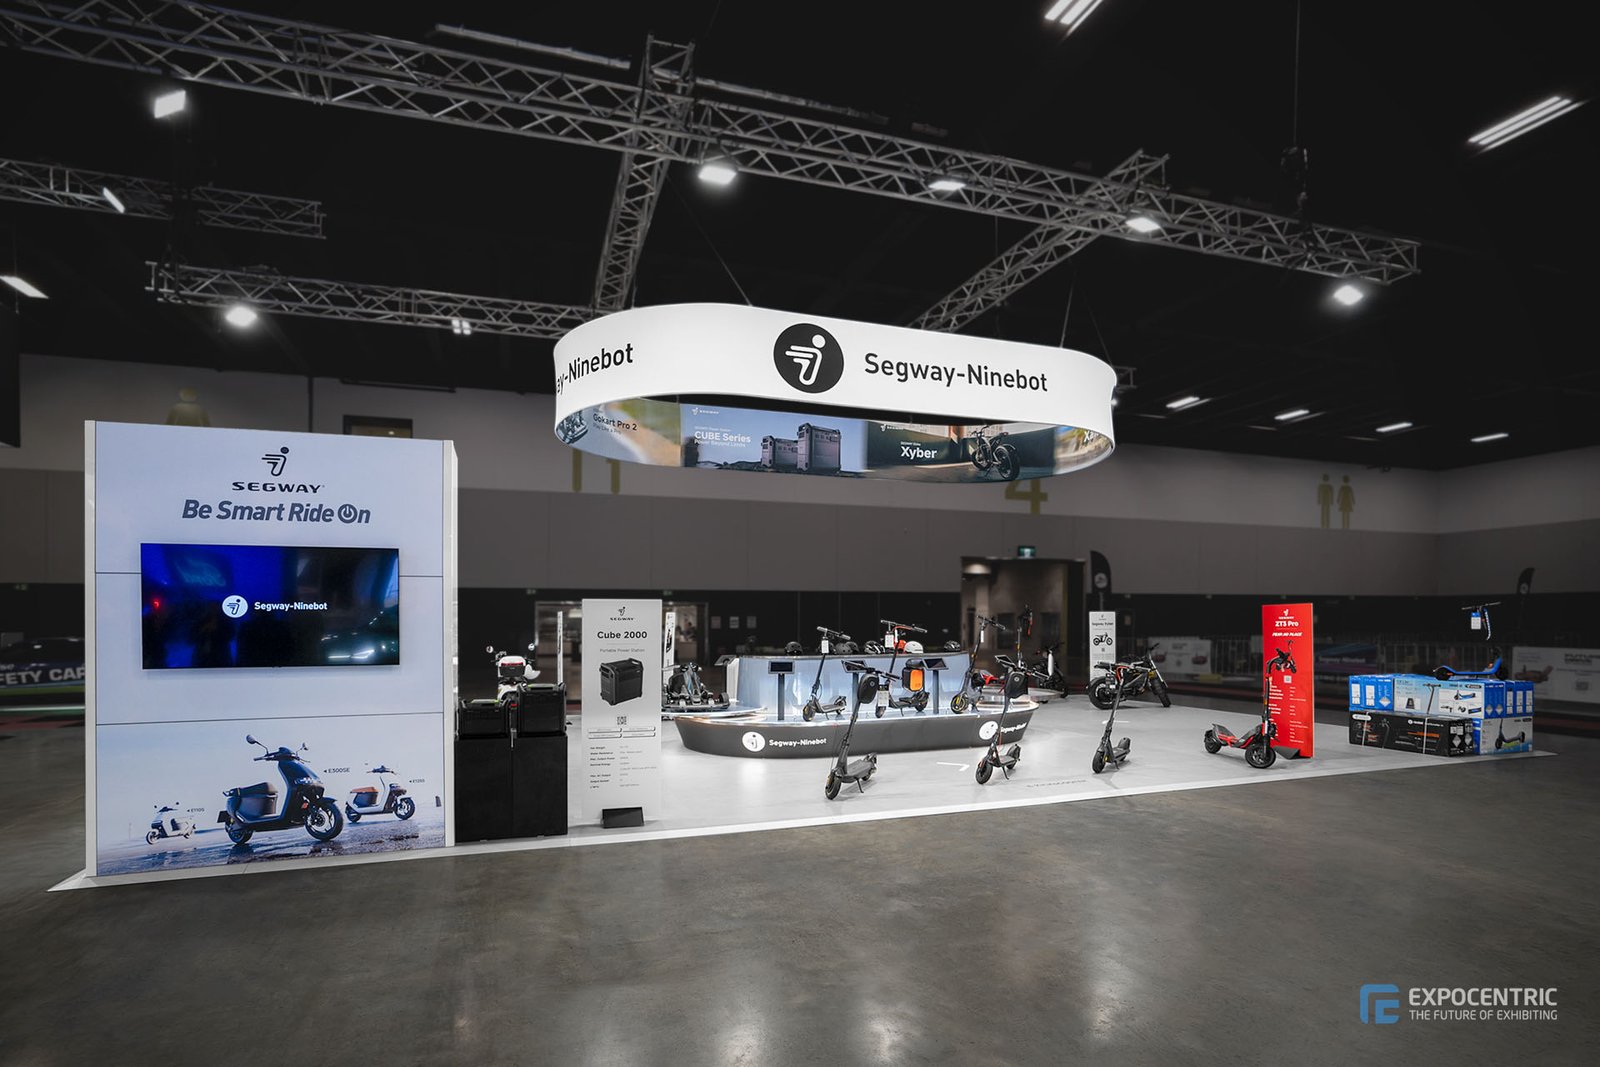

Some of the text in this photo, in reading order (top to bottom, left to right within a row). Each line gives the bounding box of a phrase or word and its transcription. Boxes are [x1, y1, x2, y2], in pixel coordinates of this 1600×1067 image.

[864, 352, 1048, 392] Segway-Ninebot
[616, 420, 631, 430] Pro
[632, 423, 638, 431] 2
[694, 431, 751, 443] CUBE Series
[901, 446, 937, 460] Xyber
[232, 481, 322, 494] SEGWAY
[182, 499, 212, 520] Be
[216, 500, 285, 522] Smart
[288, 503, 335, 523] Ride
[254, 601, 328, 611] Segway-Ninebot
[597, 631, 648, 639] Cube 2000
[769, 738, 827, 747] Segway-Ninebot
